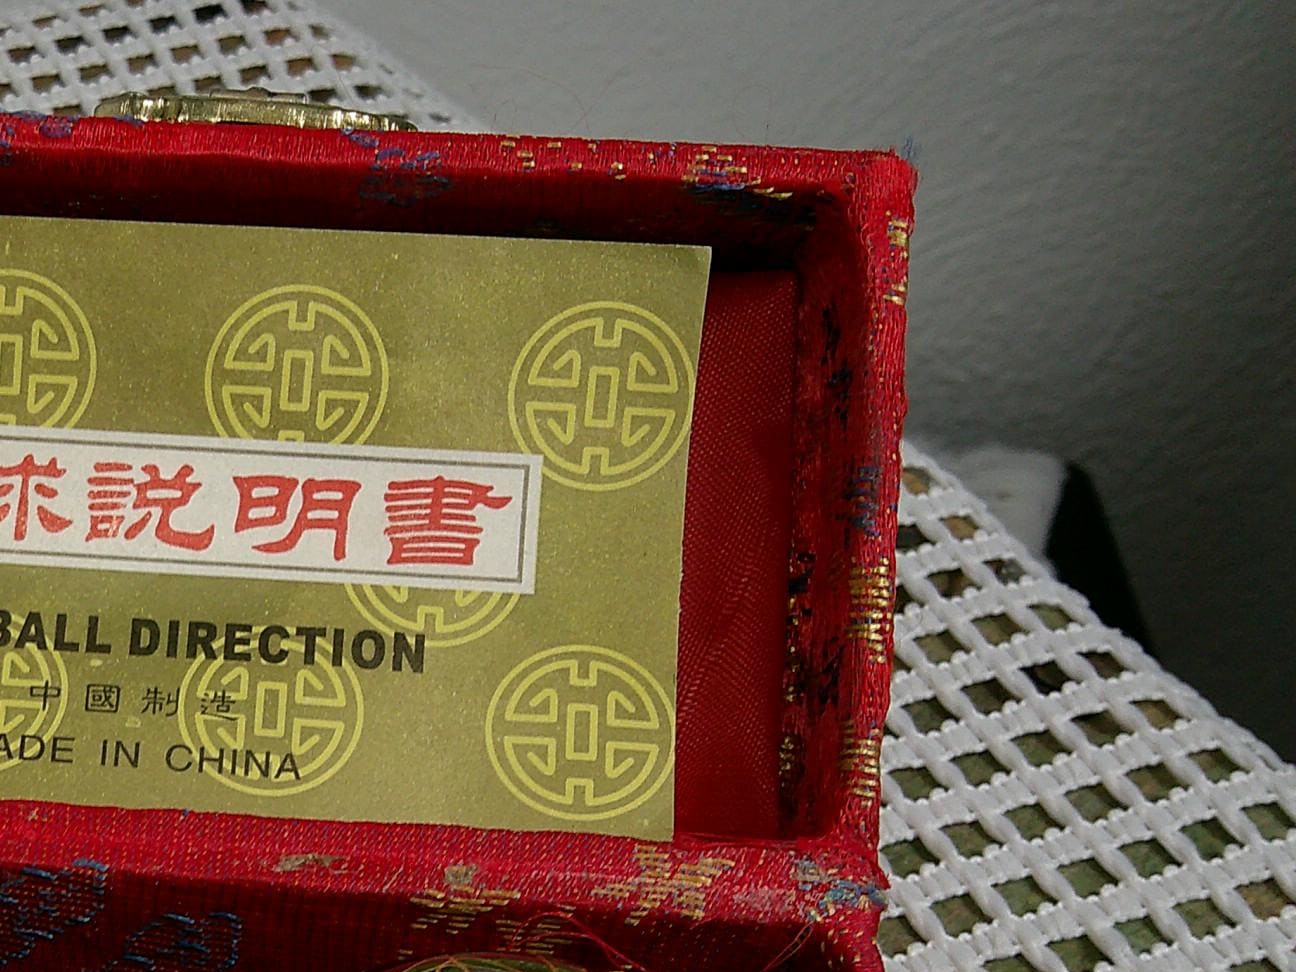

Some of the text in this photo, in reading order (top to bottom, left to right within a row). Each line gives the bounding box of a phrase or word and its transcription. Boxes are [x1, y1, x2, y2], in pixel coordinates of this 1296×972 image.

[129, 618, 426, 673] DIRECTION
[100, 739, 141, 768] IN
[165, 744, 302, 780] CHINA
